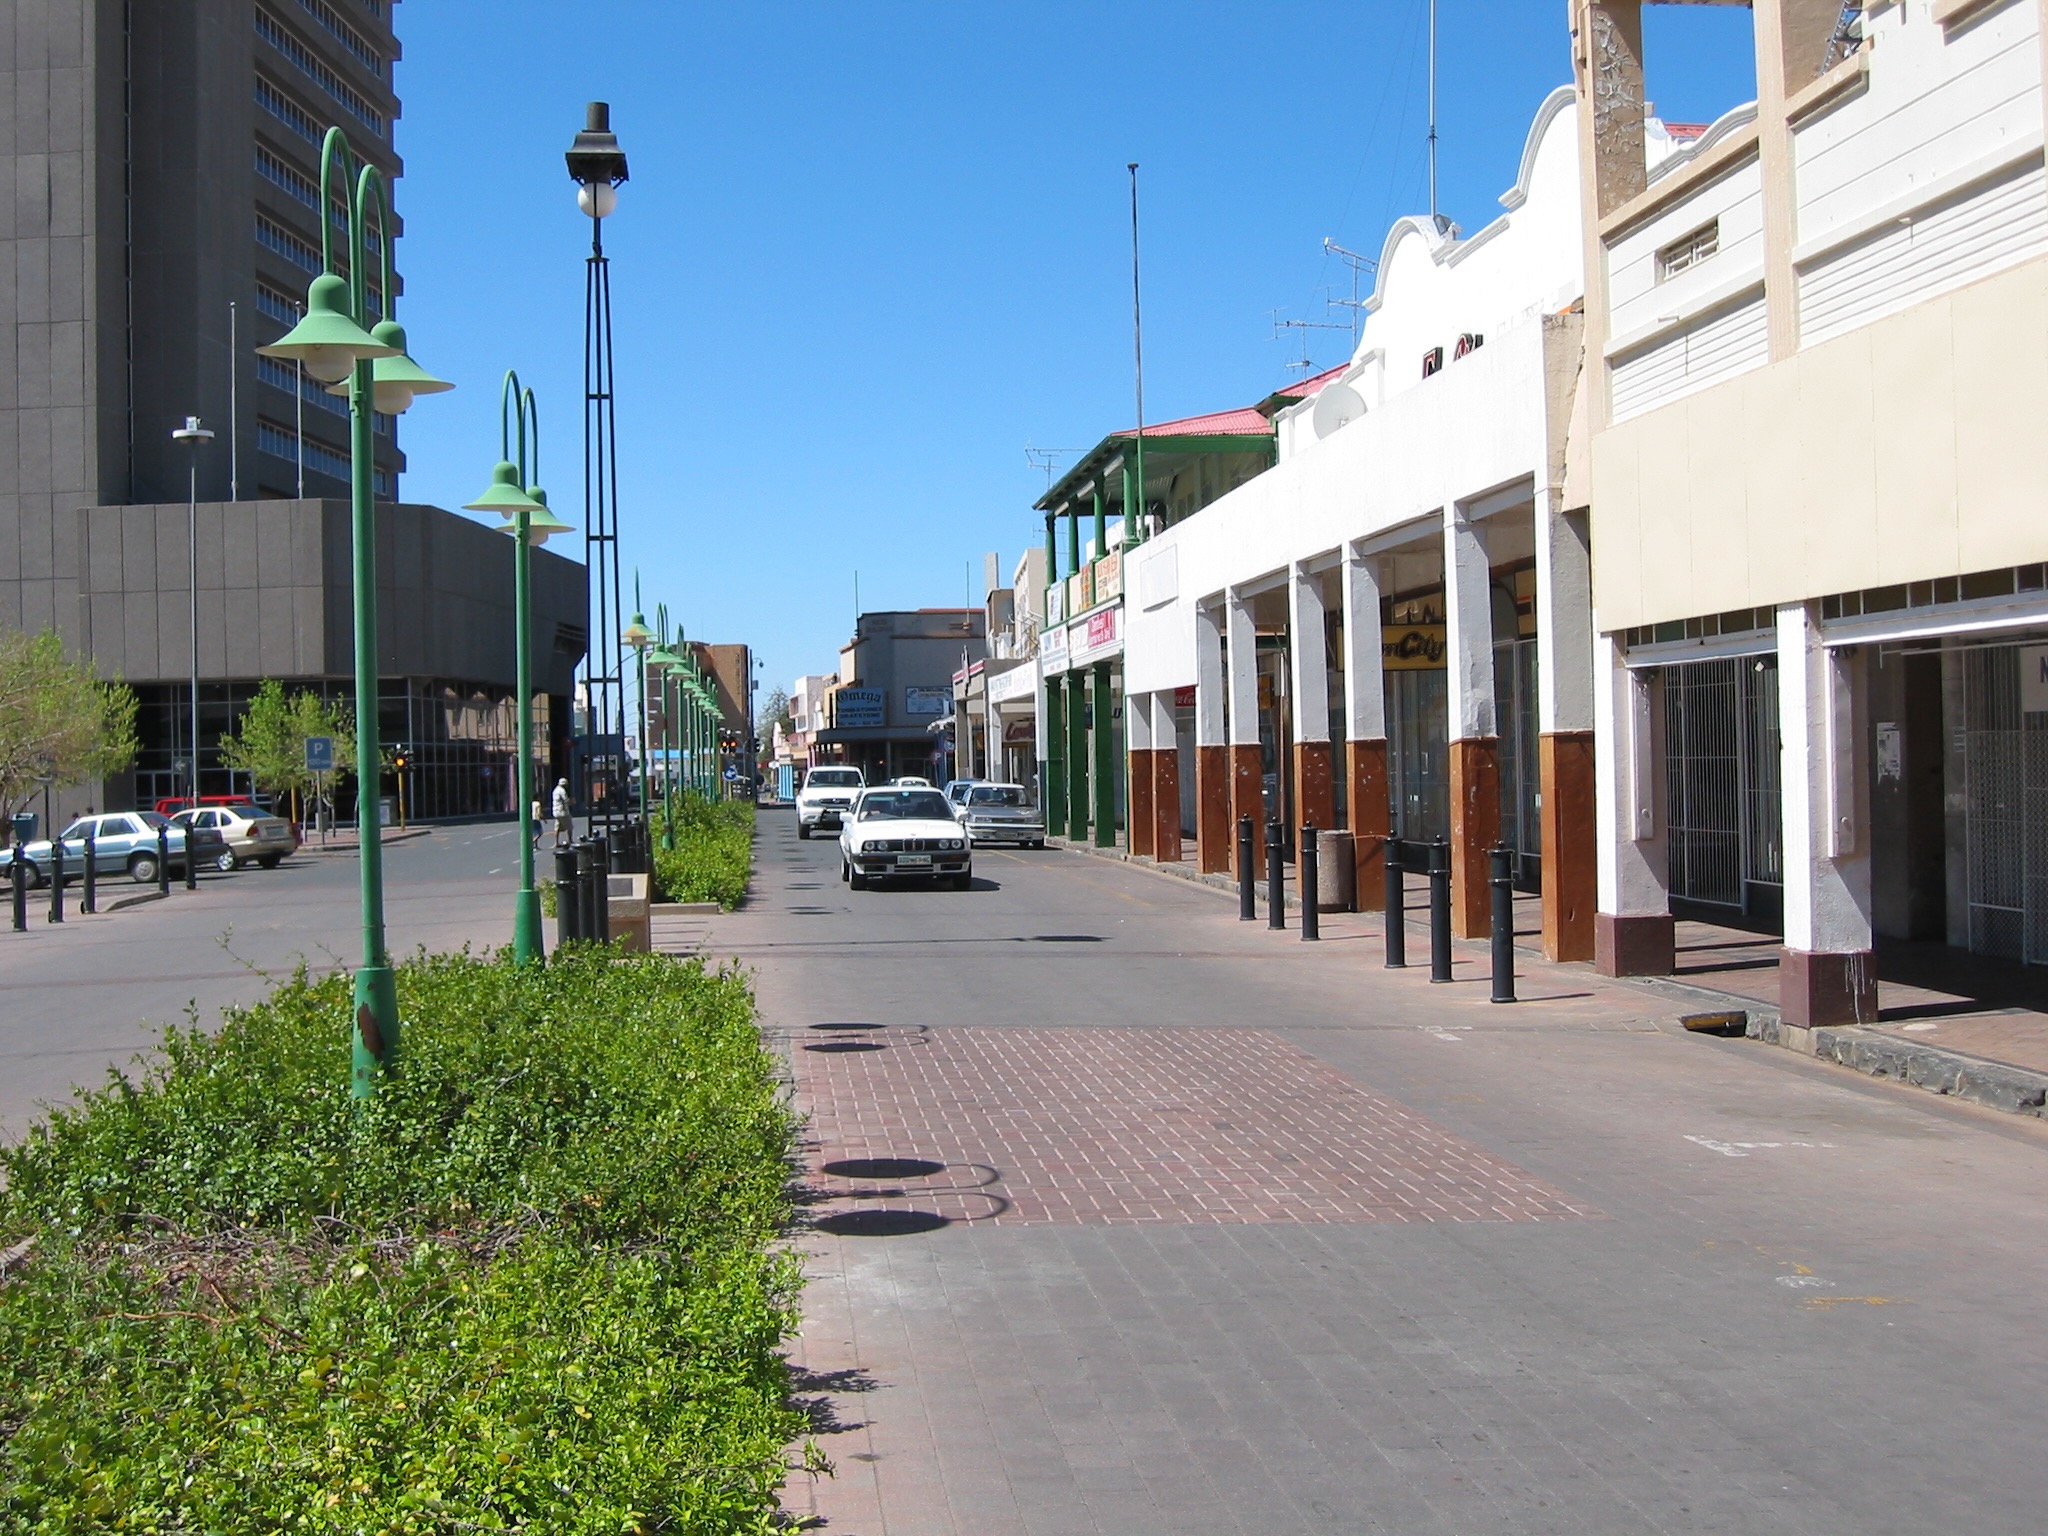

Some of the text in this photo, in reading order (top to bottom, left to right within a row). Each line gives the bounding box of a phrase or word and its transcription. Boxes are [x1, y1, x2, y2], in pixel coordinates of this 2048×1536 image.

[838, 690, 881, 703] Omega
[314, 742, 323, 755] P
[935, 753, 942, 761] P
